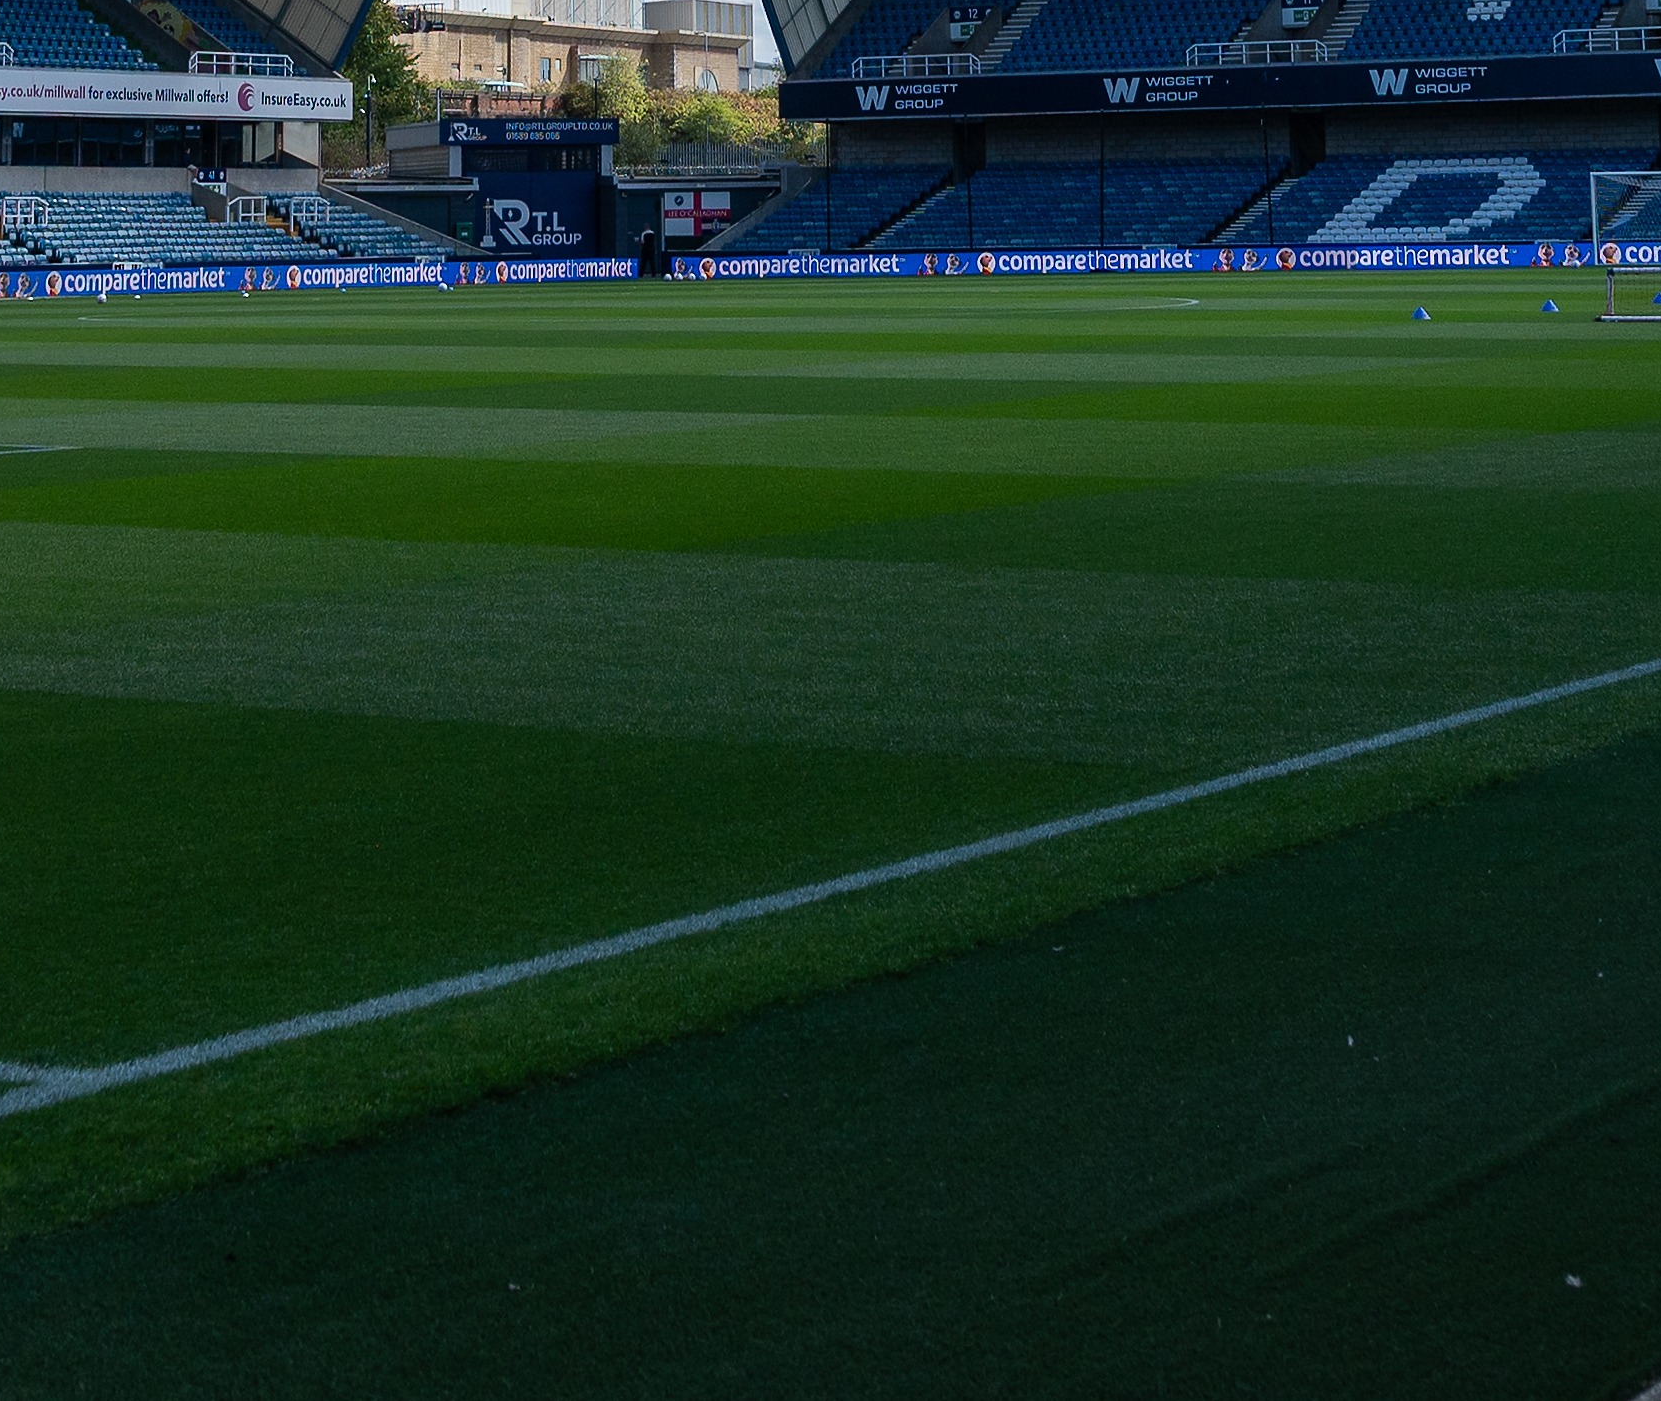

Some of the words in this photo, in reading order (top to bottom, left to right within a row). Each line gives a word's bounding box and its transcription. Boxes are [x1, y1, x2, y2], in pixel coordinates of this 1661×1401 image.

[968, 9, 978, 19] 12
[1415, 66, 1488, 78] WIGGETT
[1145, 75, 1213, 86] WIGGETT
[895, 84, 959, 95] WIGGETT
[1415, 82, 1472, 94] GROUP
[88, 86, 103, 99] for
[105, 88, 152, 101] exclusive
[155, 89, 195, 103] Millwall
[197, 90, 229, 104] offers!
[261, 91, 346, 110] InsureEasy.co.uk
[1145, 91, 1198, 102] GROUP
[895, 99, 944, 110] GROUP
[208, 170, 215, 179] 41
[532, 233, 583, 246] GROUP
[998, 249, 1193, 274] comparethemarket
[1299, 244, 1510, 269] comparethemarket
[510, 258, 632, 283] comparethemarket
[719, 254, 900, 278] comparethemarket
[62, 266, 225, 295] comparethemarket
[303, 262, 443, 288] comparethemarket
